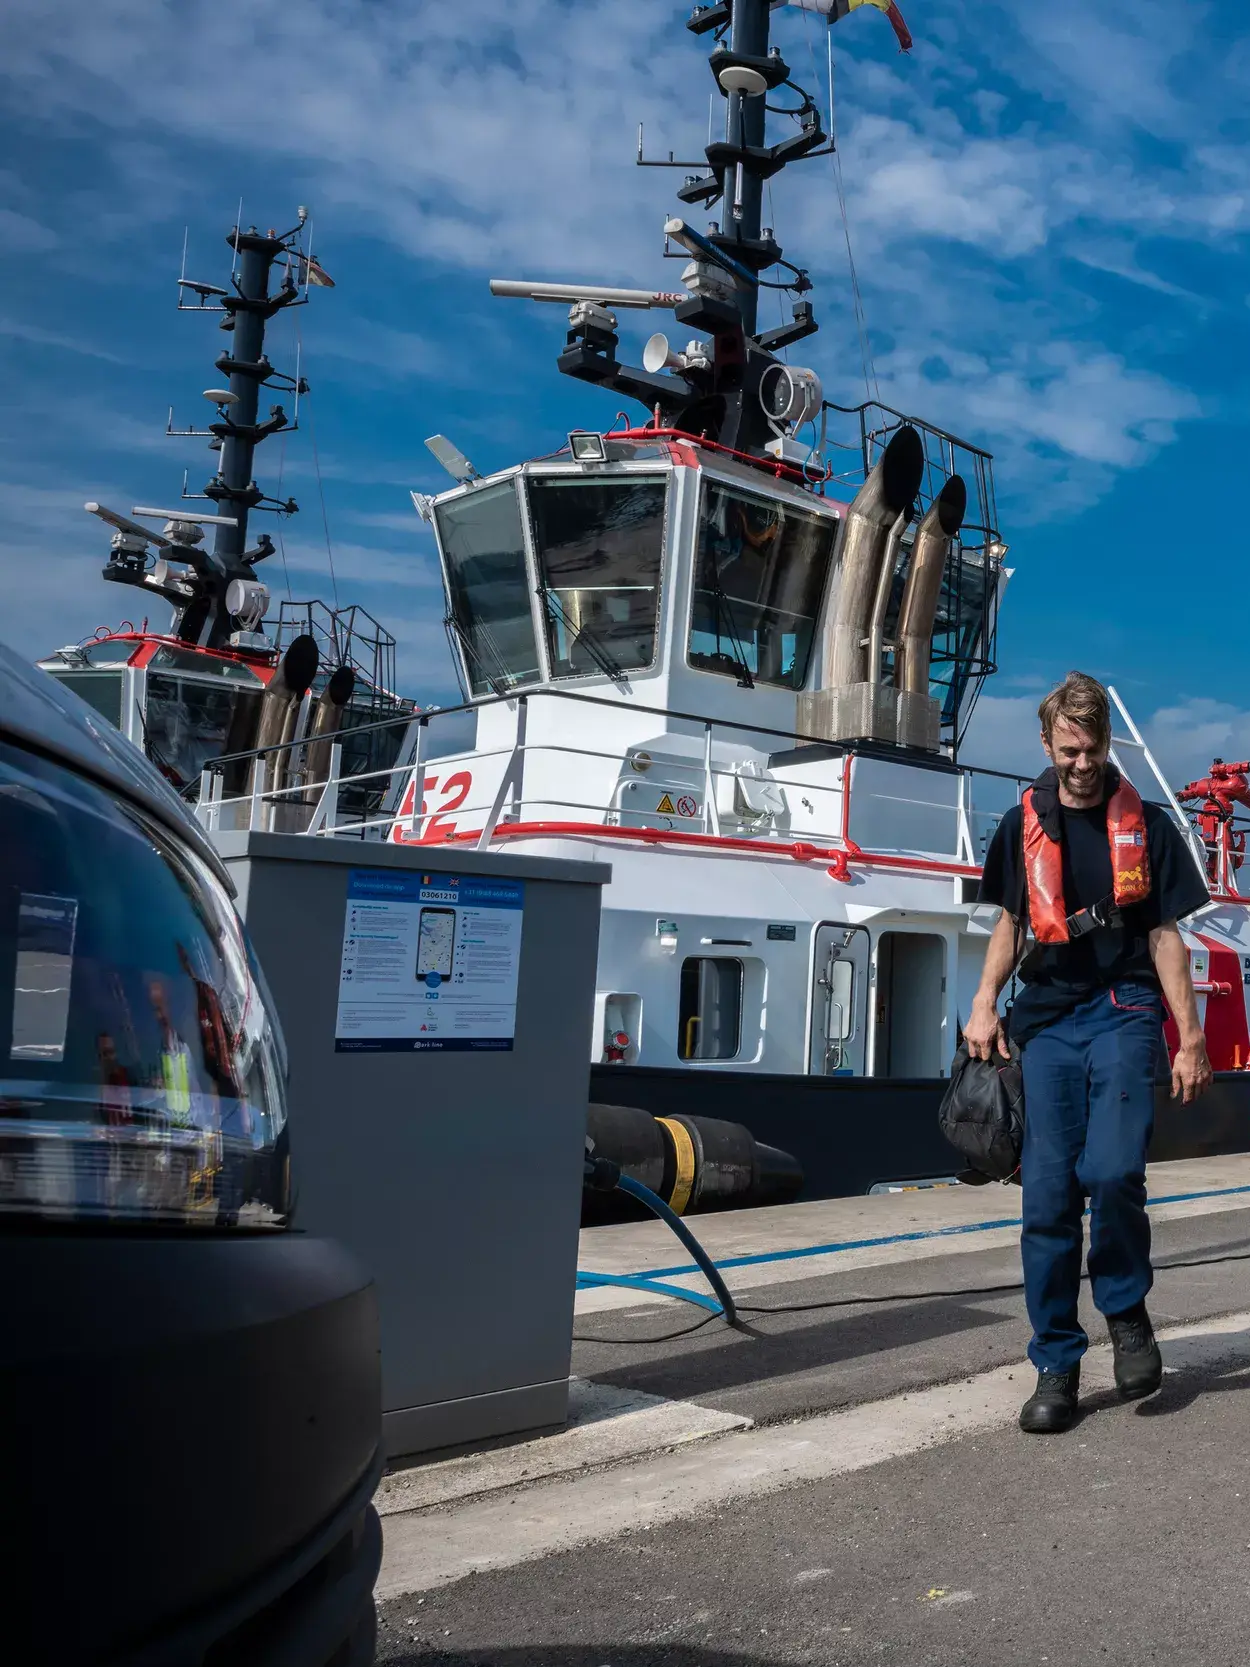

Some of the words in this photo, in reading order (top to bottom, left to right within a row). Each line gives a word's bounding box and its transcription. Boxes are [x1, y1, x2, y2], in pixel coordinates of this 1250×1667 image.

[652, 292, 682, 302] JRC
[393, 771, 472, 844] 52
[421, 891, 457, 900] 03061210
